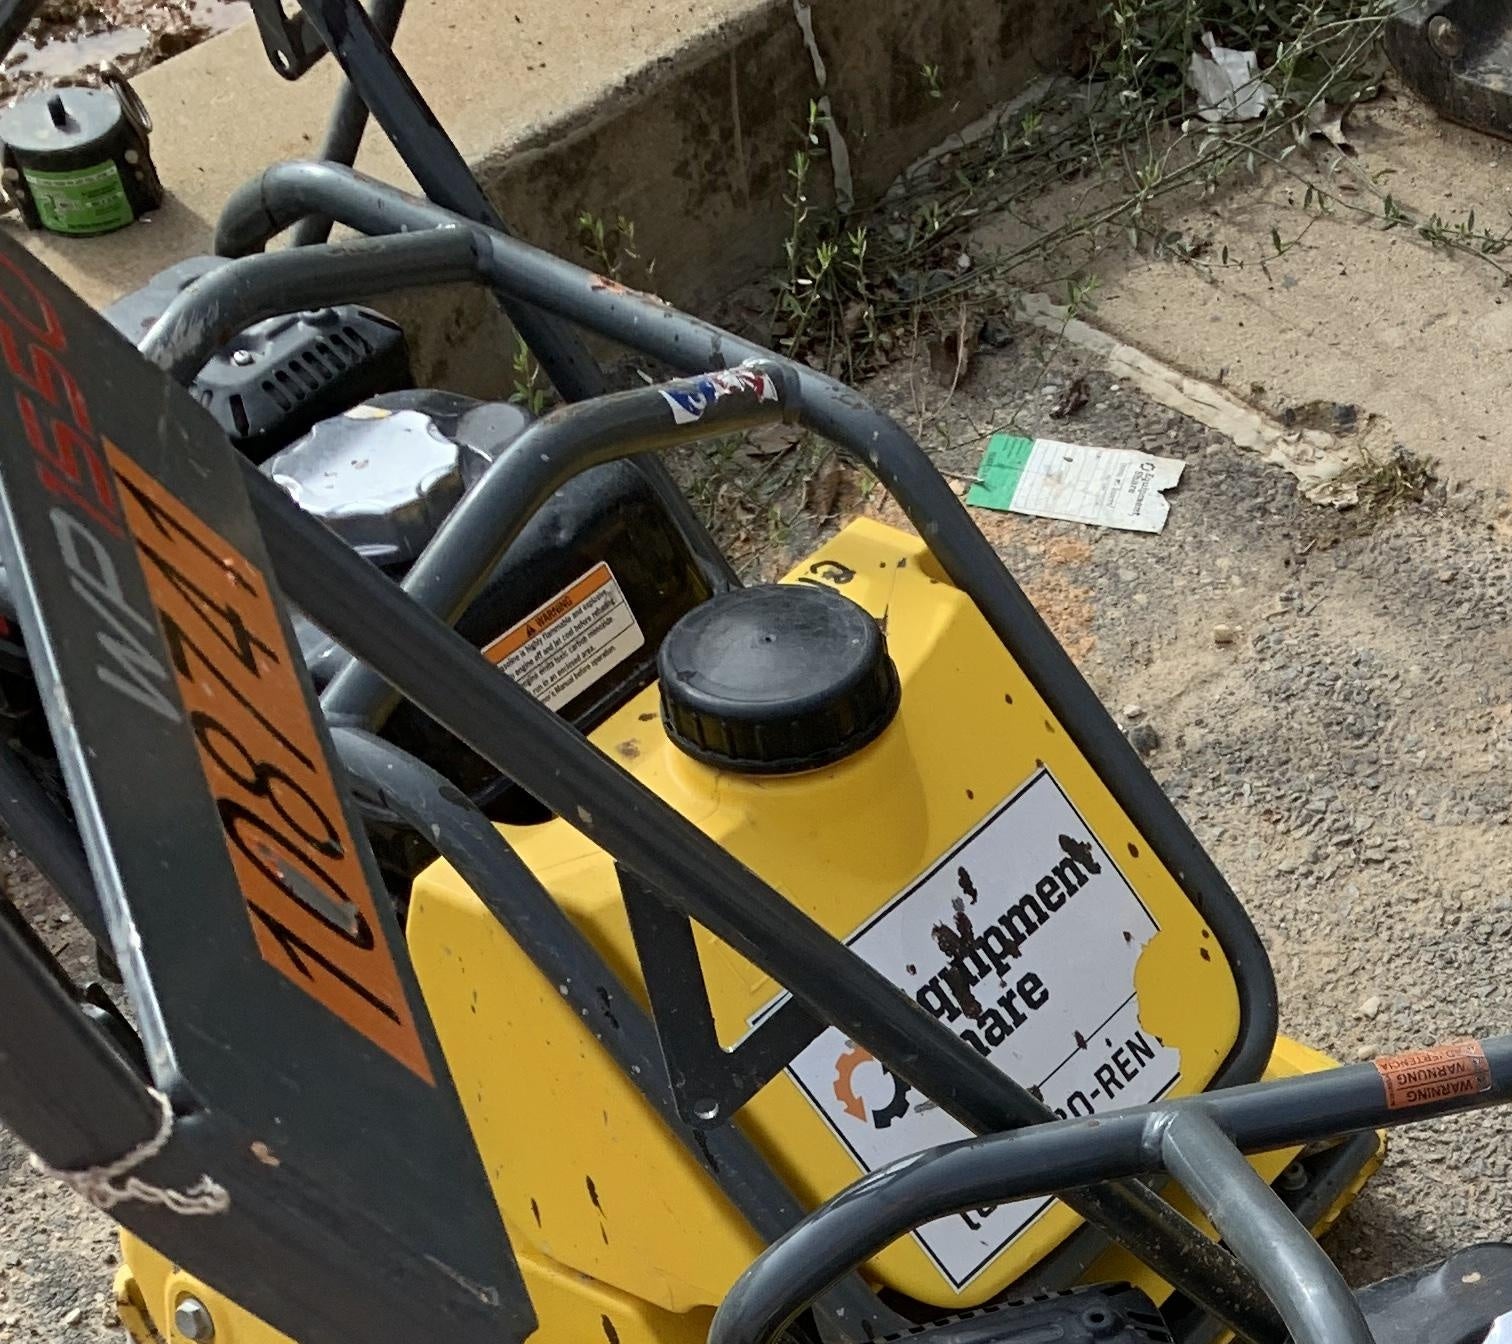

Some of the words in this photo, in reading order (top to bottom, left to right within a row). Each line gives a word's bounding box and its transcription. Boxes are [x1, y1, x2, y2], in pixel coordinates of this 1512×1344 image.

[536, 596, 573, 627] WARNING
[114, 468, 402, 1026] 108741
[916, 842, 1101, 1022] quipment
[960, 972, 1049, 1057] are
[1406, 1079, 1474, 1102] WARNING
